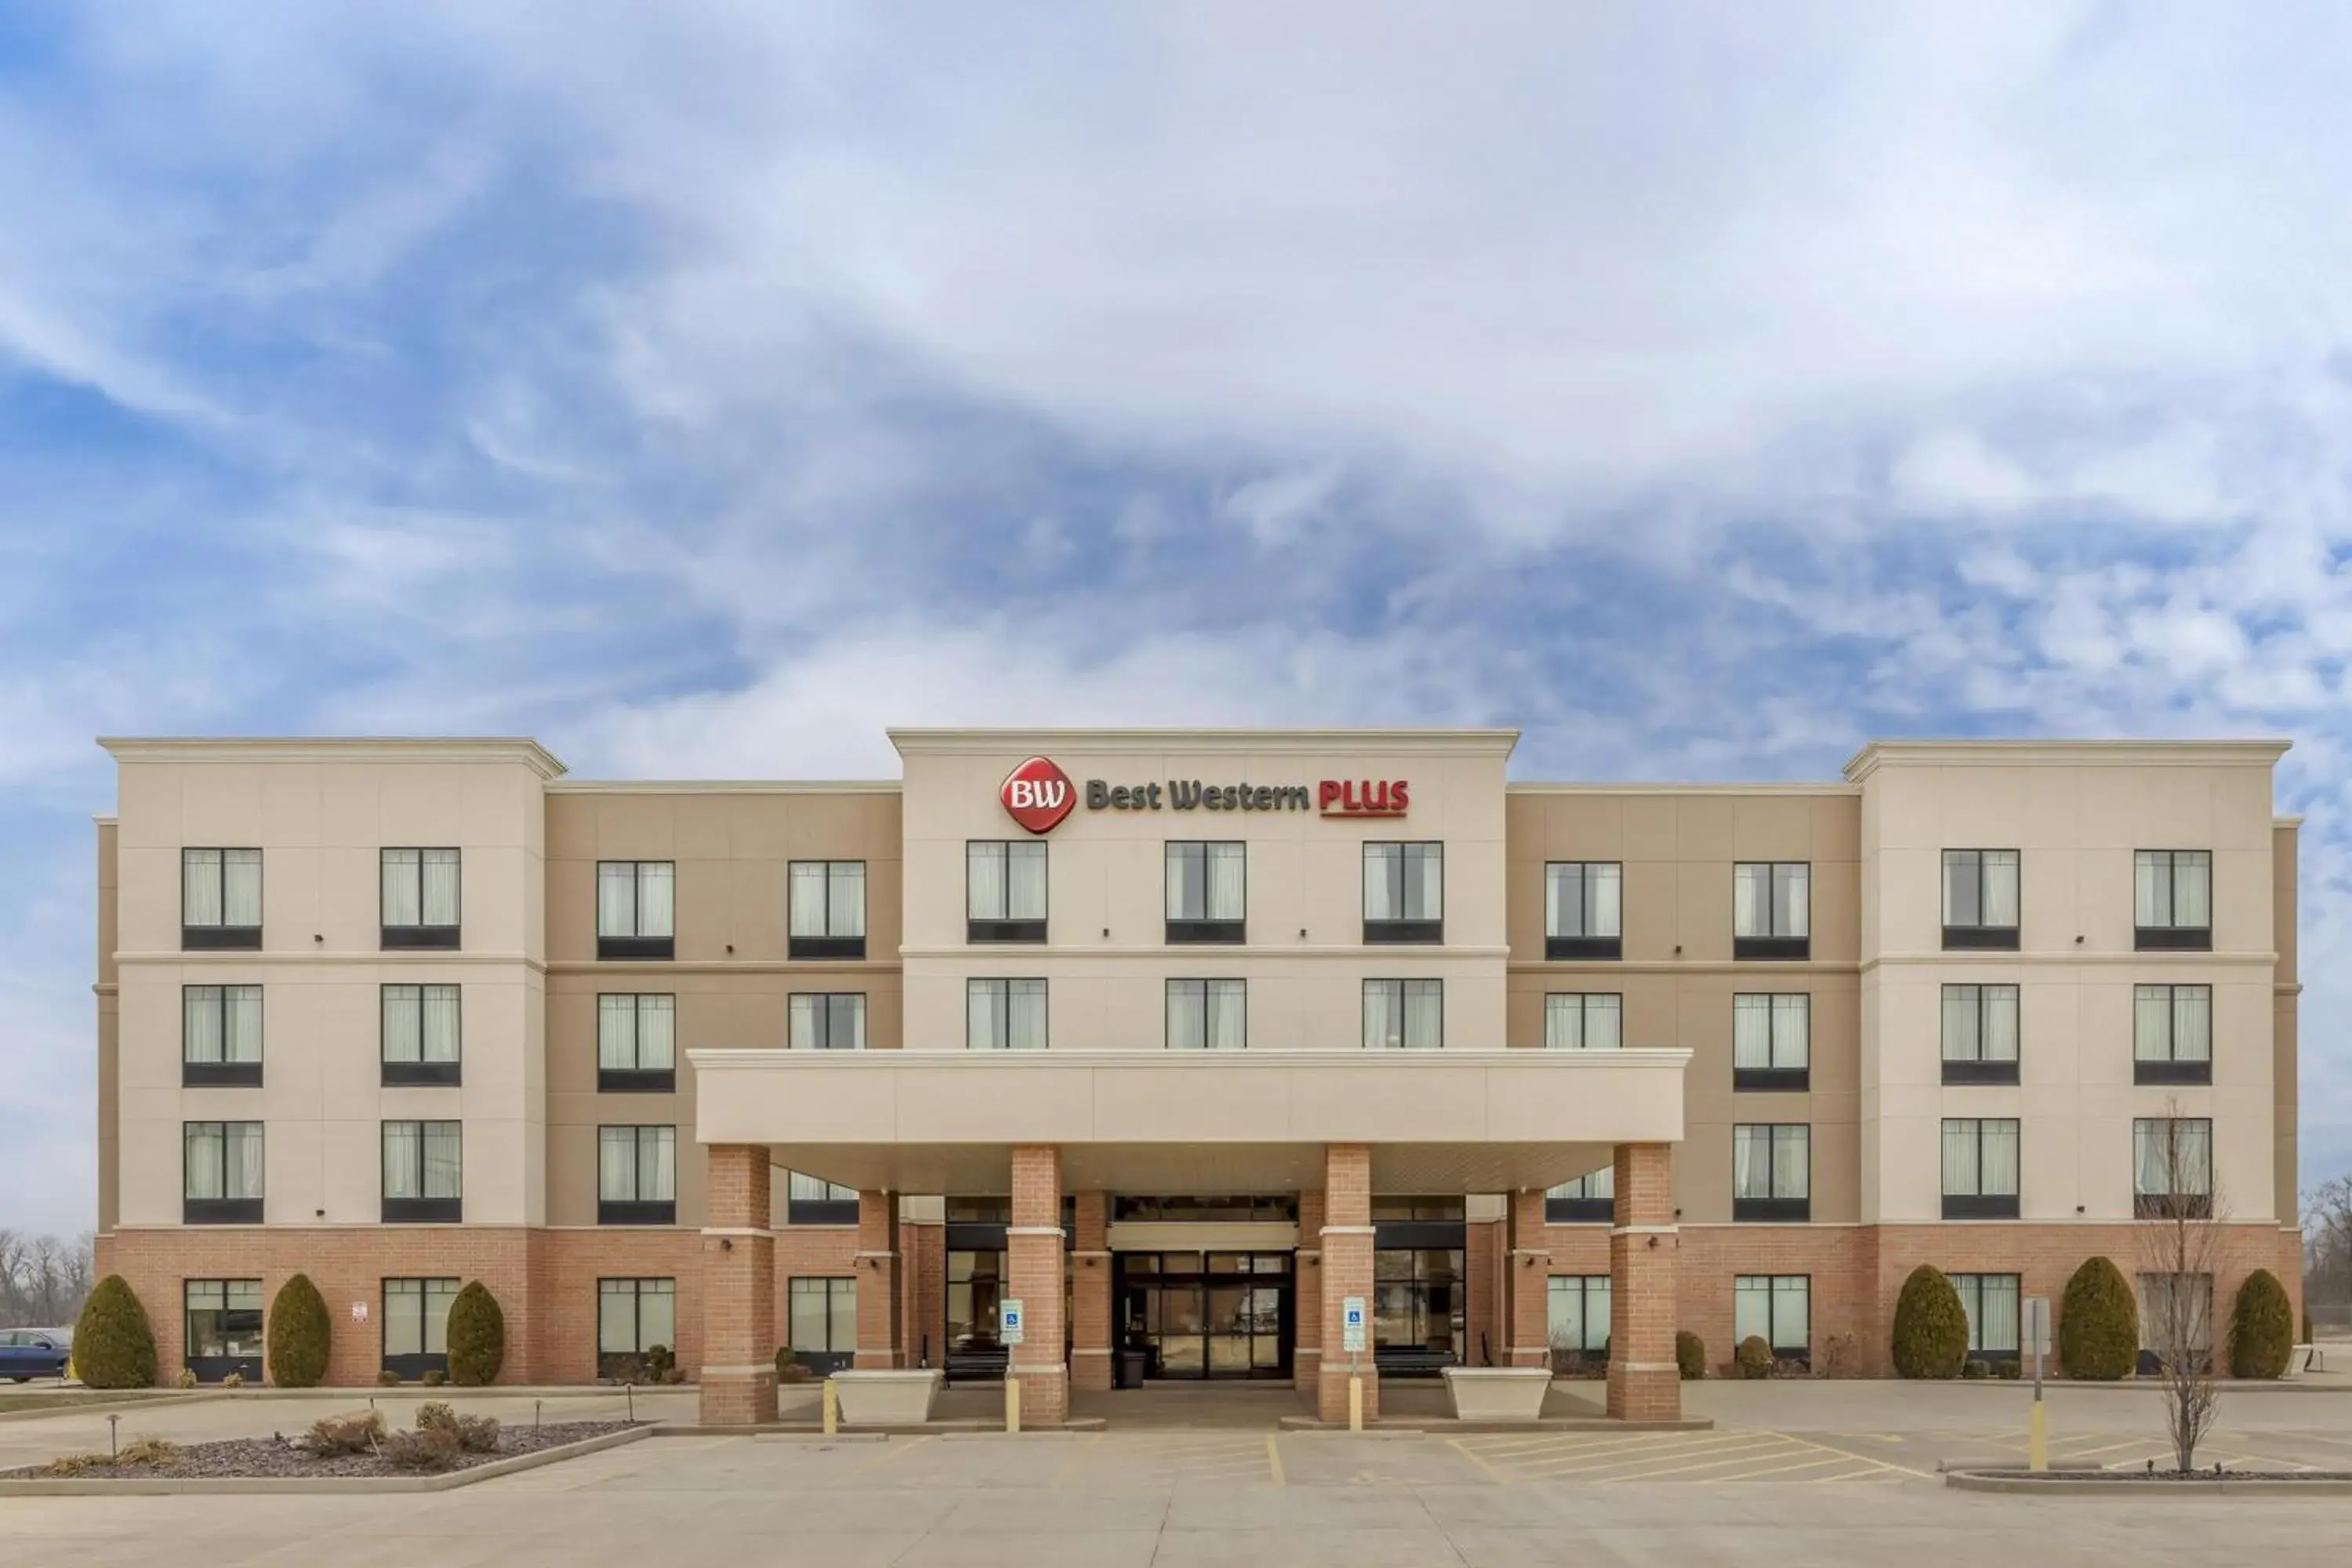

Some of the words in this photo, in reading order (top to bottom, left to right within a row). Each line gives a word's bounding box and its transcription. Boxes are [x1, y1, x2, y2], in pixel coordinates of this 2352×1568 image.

[1011, 780, 1065, 808] BW
[1085, 779, 1162, 810] Best
[1169, 779, 1310, 810] Western
[1319, 780, 1410, 810] PLUS
